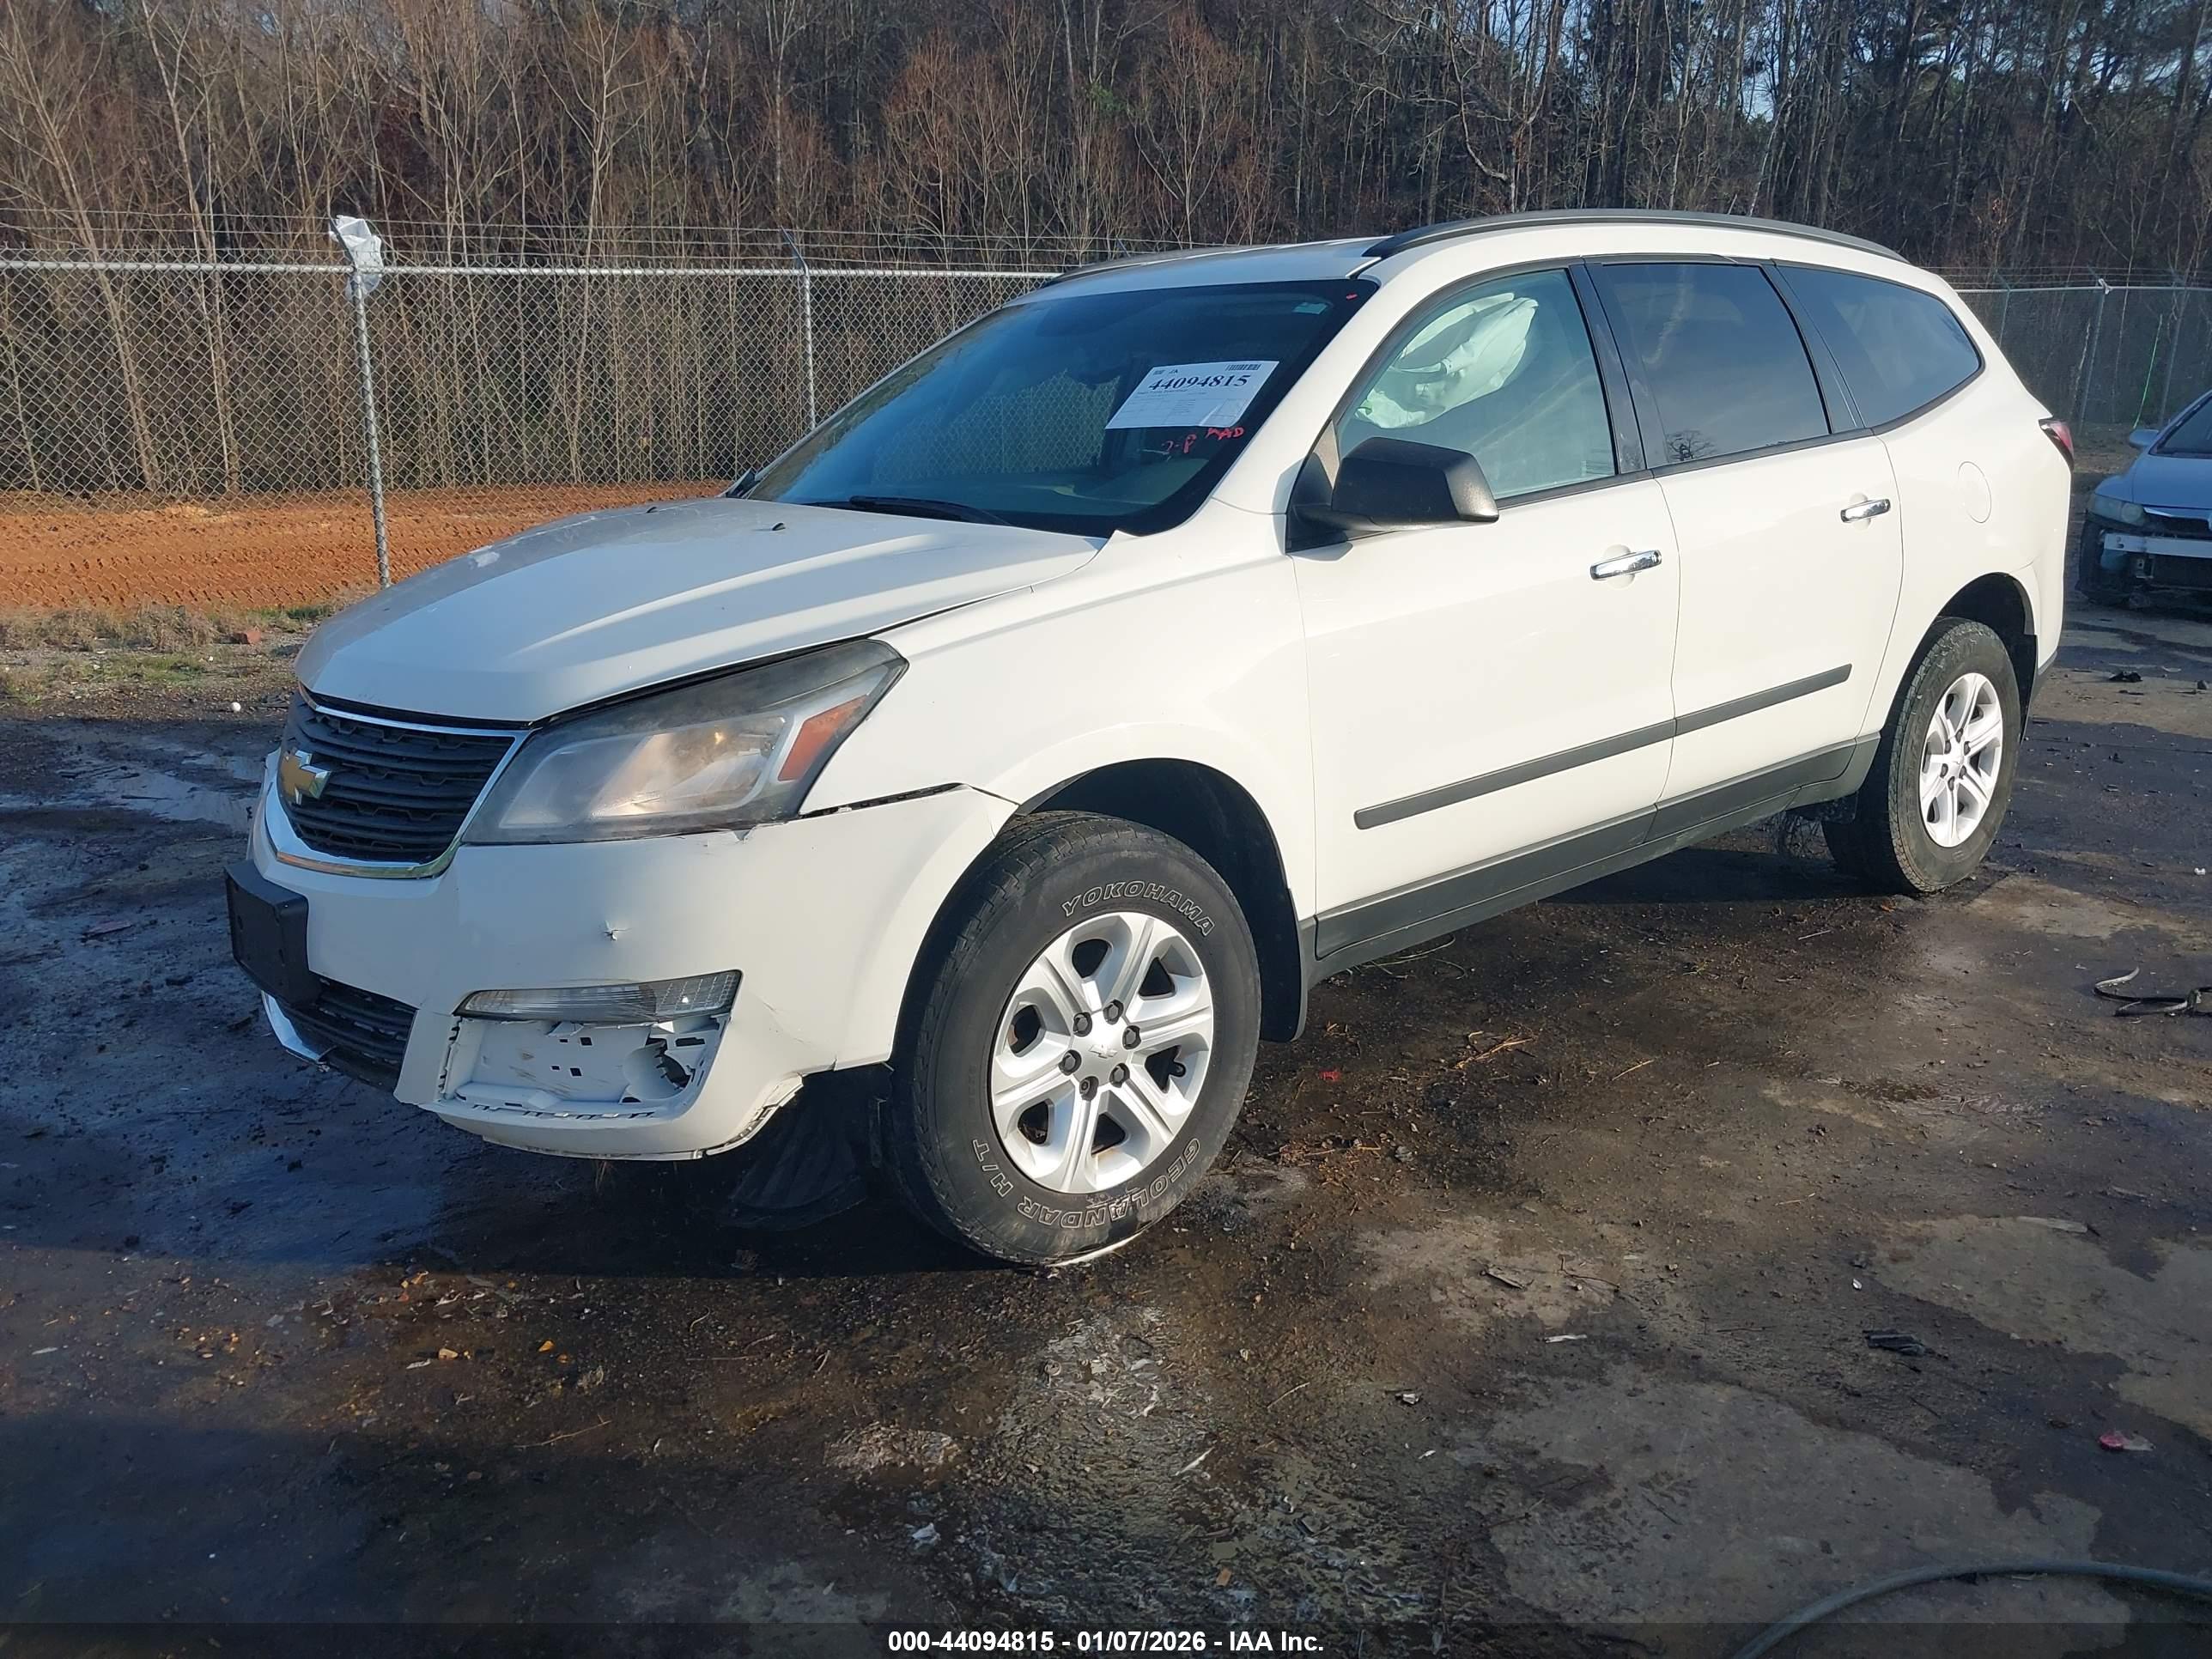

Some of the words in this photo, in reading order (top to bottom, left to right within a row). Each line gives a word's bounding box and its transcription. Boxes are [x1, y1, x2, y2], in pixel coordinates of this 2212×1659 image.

[1148, 374, 1250, 391] 44094815
[1061, 880, 1216, 937] YOKOHAMA
[973, 1139, 1014, 1198] H/T
[1017, 1138, 1200, 1229] GEOLANDAR
